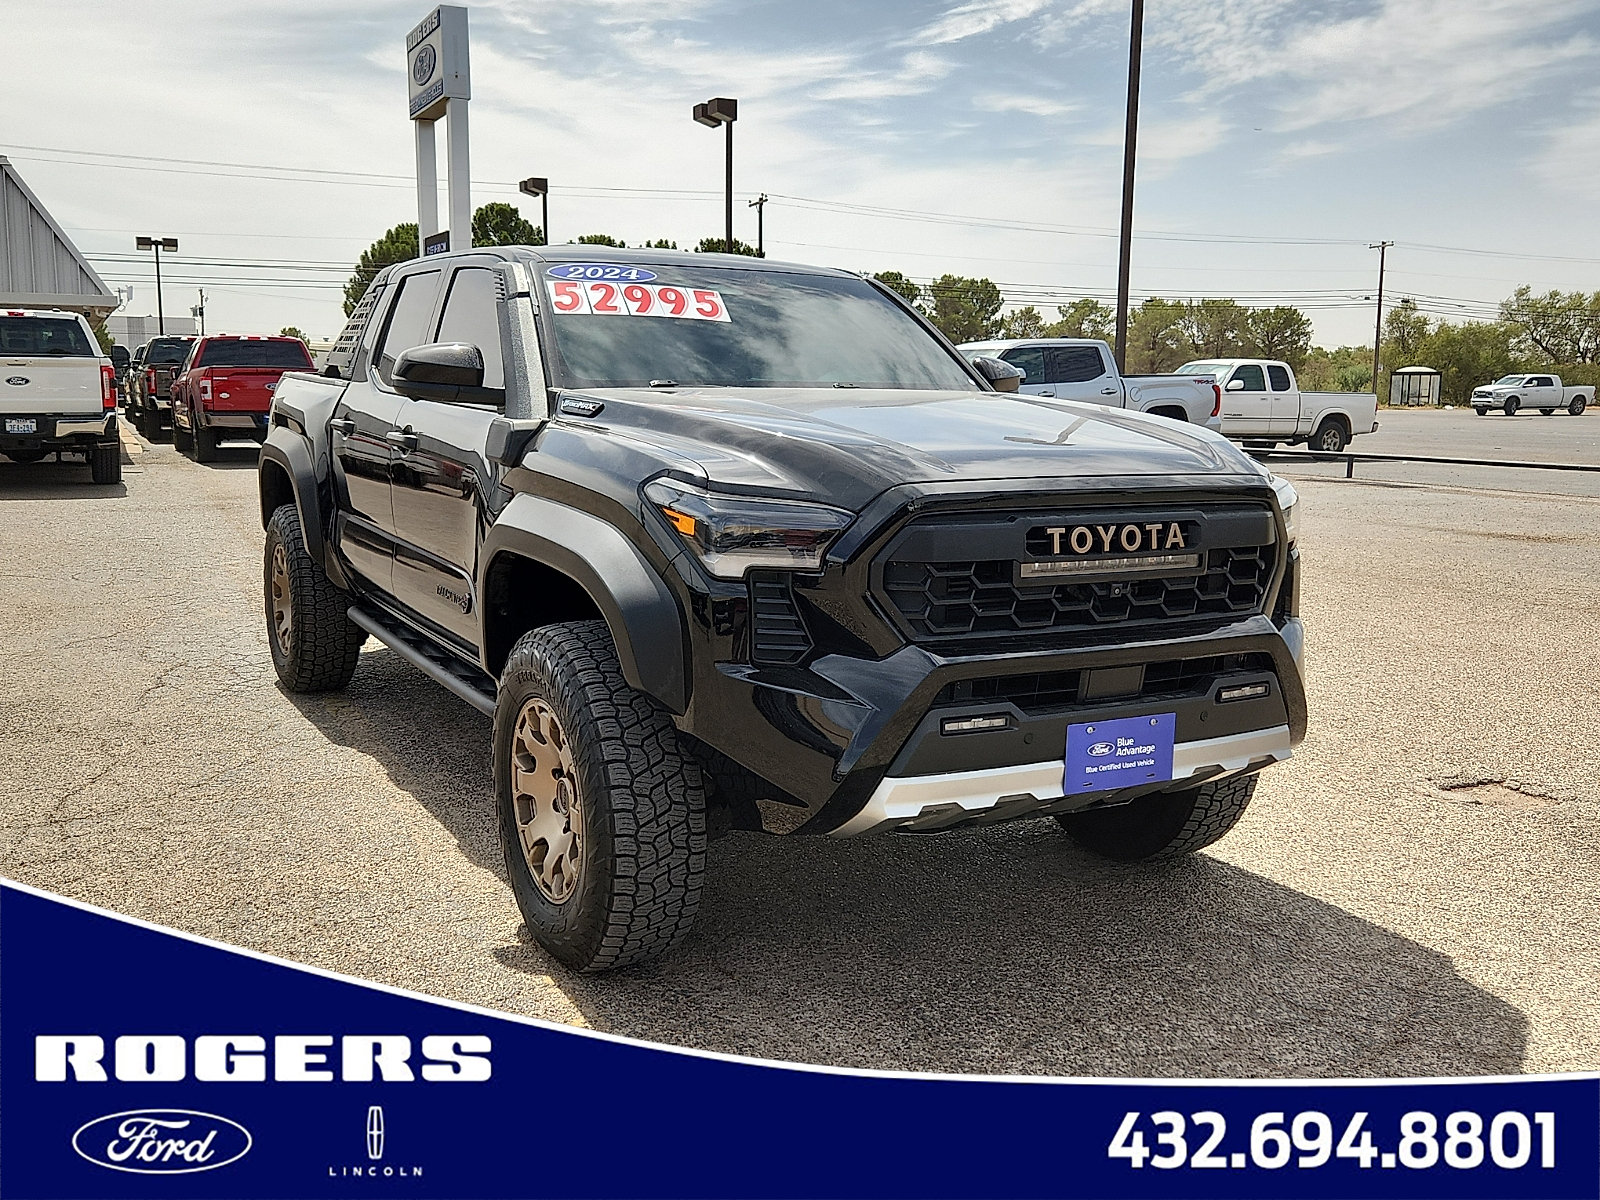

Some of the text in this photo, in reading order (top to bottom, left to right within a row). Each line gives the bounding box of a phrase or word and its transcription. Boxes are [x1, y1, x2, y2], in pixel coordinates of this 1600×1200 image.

[407, 12, 440, 49] ROGERS
[566, 267, 640, 280] 2024
[553, 282, 723, 318] 52995
[9, 377, 26, 385] Ford
[1047, 522, 1185, 554] TOYOTA
[1117, 737, 1134, 746] Blue
[1092, 744, 1110, 754] Ford
[1116, 745, 1155, 756] Advantage
[1099, 763, 1121, 771] Certified
[1137, 759, 1154, 767] Vehicle
